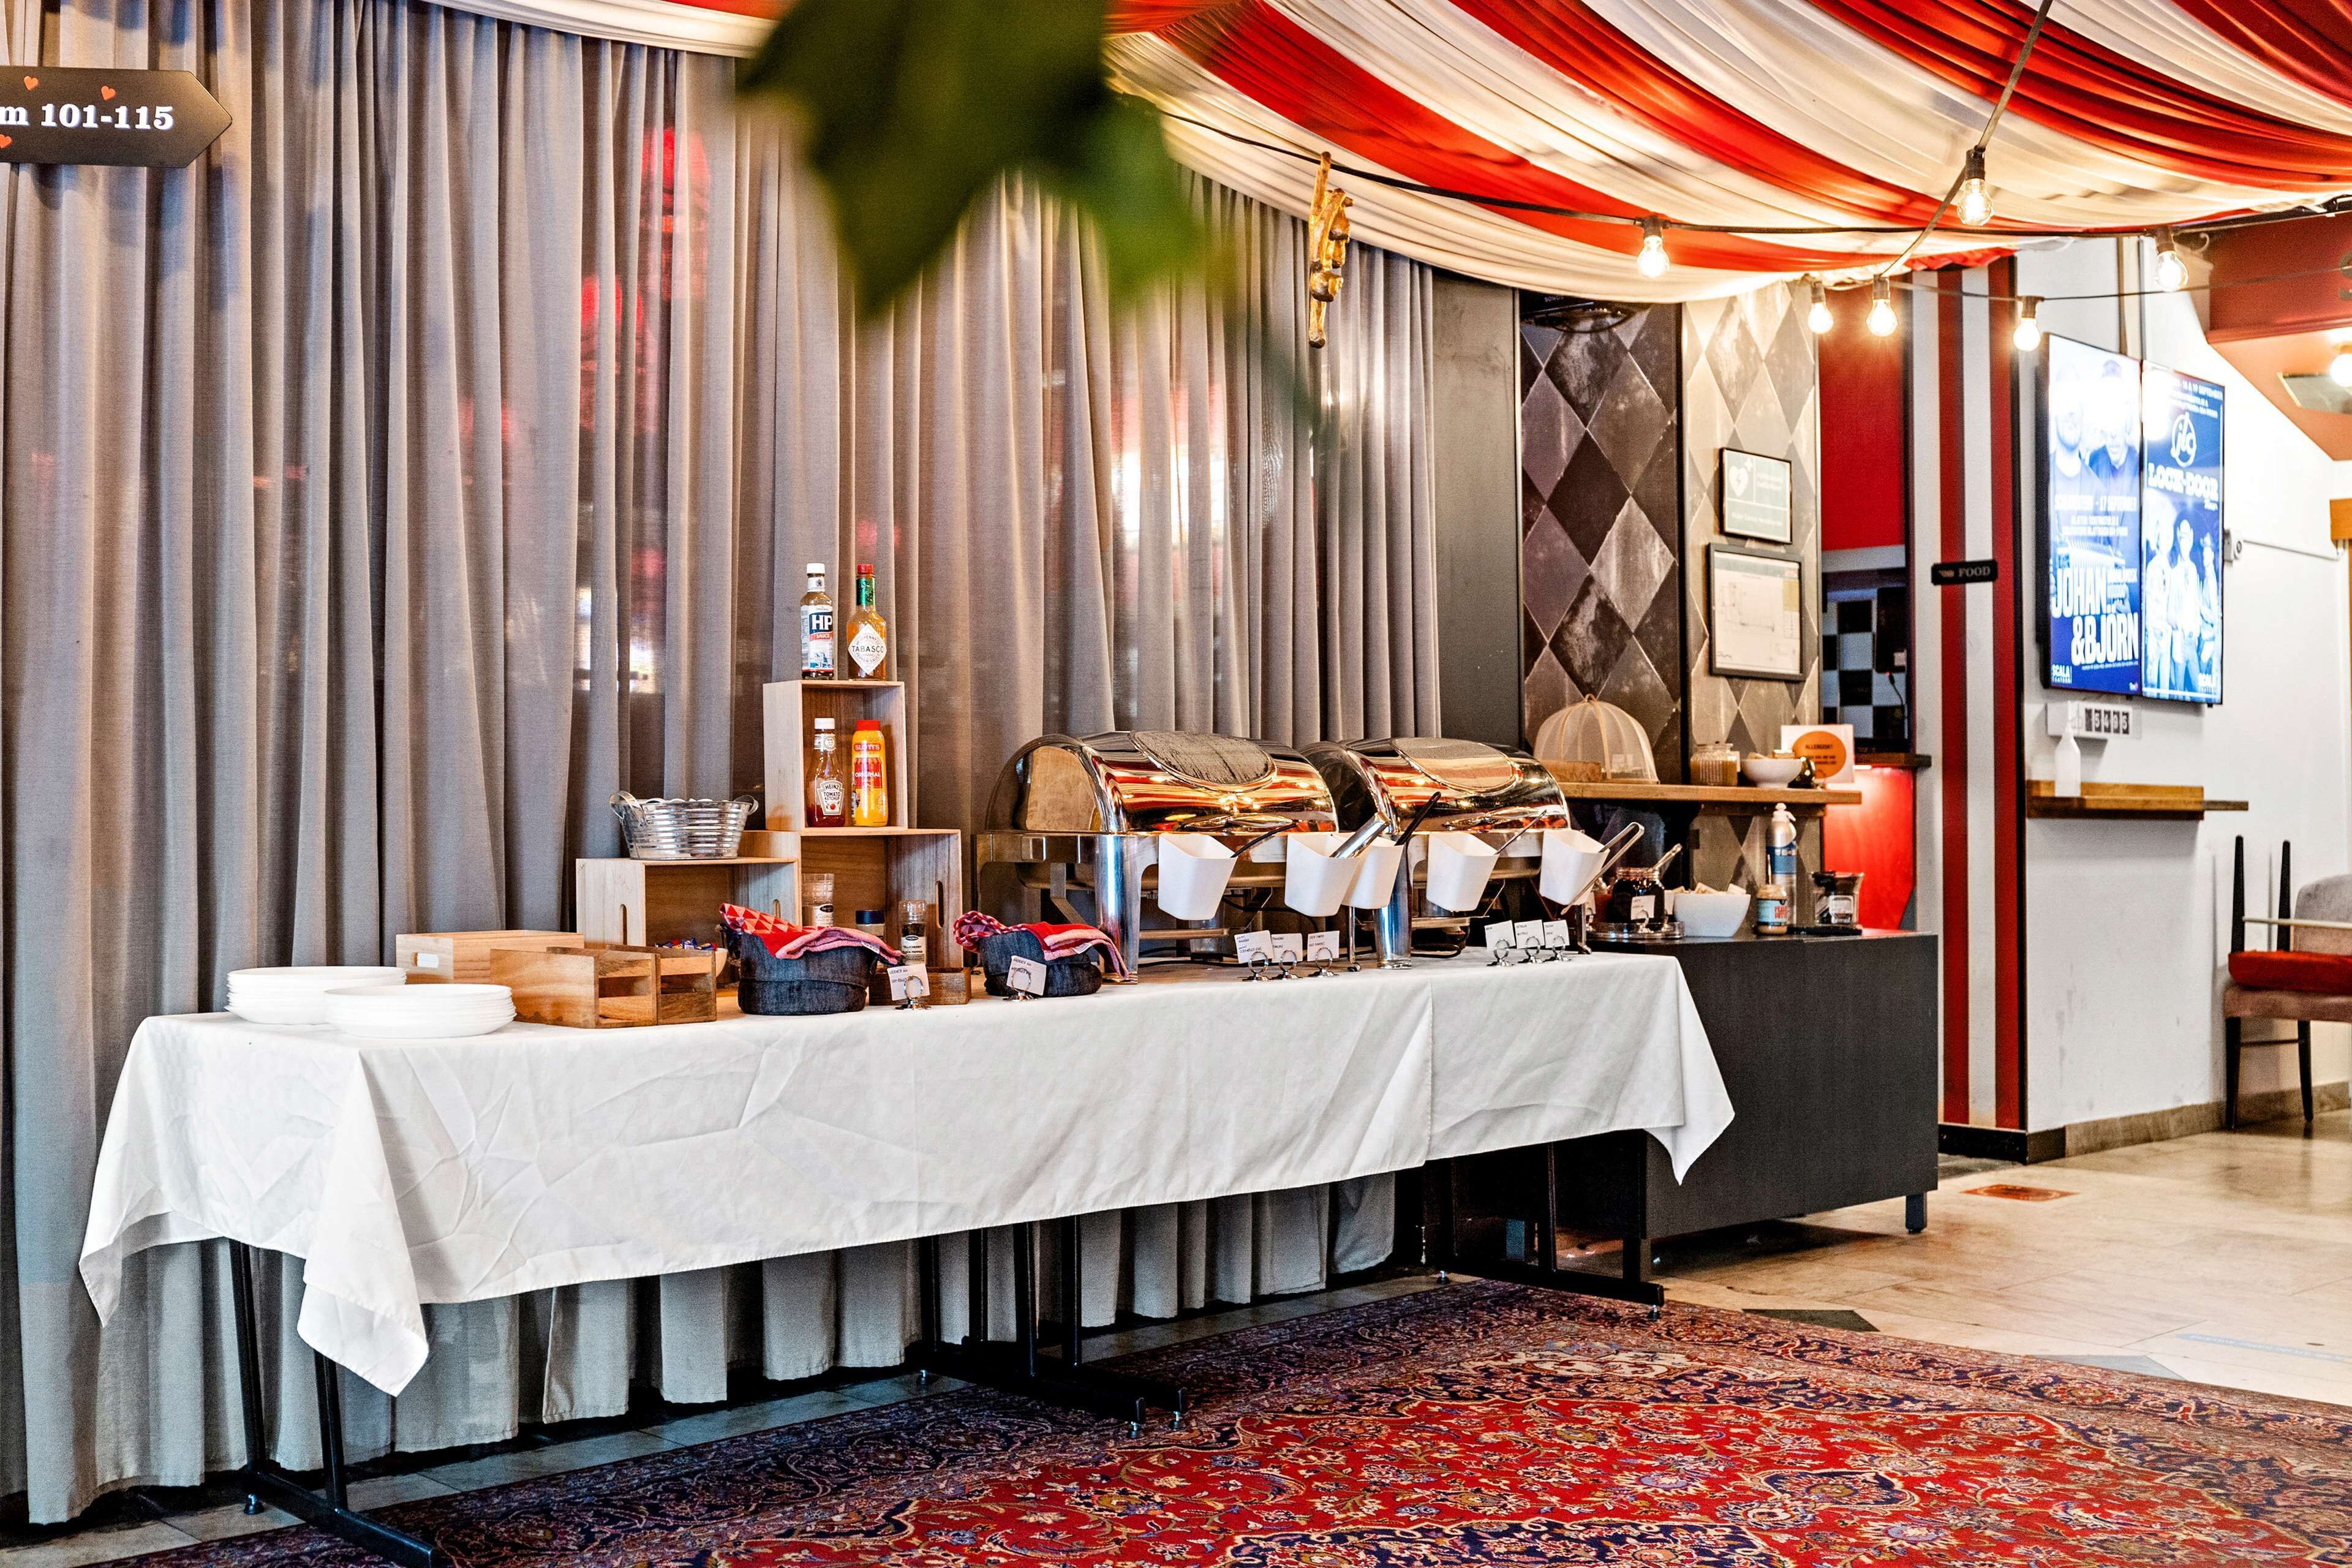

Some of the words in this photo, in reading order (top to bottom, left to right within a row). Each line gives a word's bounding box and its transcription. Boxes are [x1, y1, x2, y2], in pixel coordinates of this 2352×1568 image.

[40, 103, 174, 130] 101-115
[1958, 566, 1991, 578] FOOD
[2052, 568, 2106, 619] JOHAN
[812, 615, 832, 630] HP
[2052, 664, 2070, 677] SCALA
